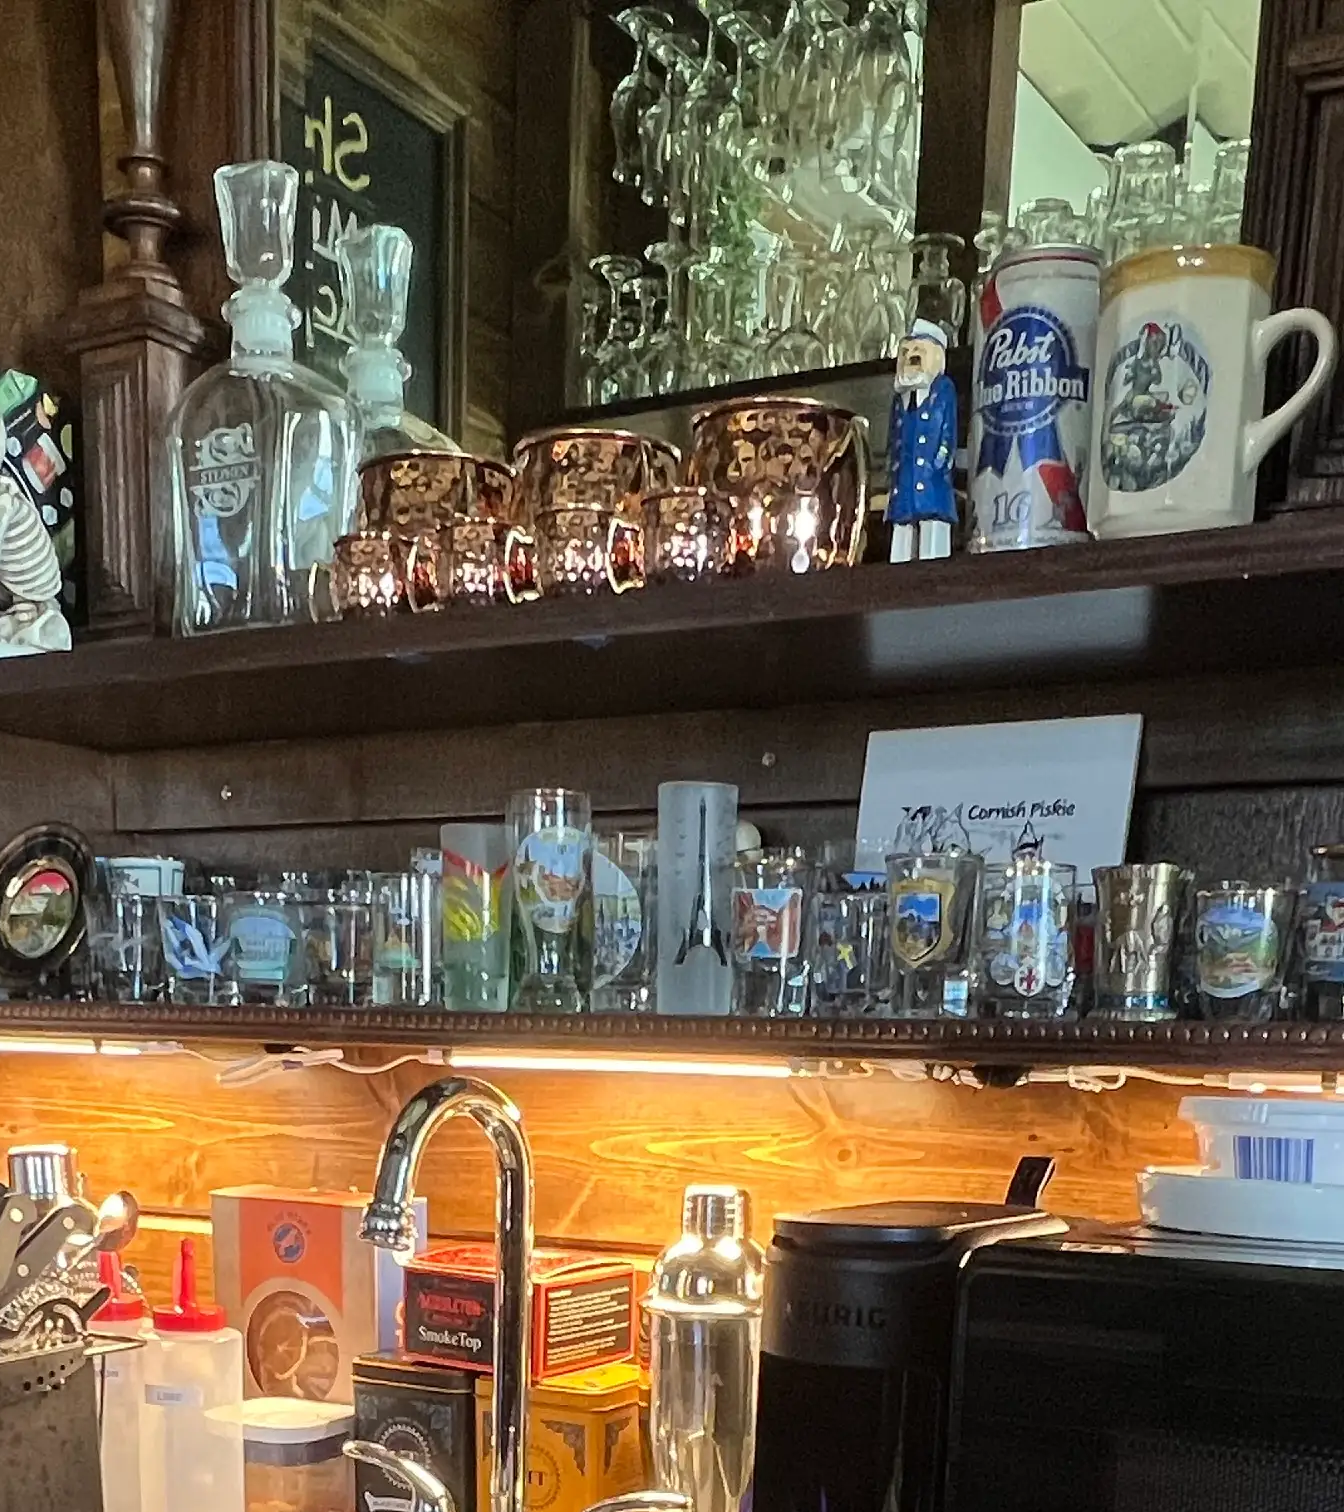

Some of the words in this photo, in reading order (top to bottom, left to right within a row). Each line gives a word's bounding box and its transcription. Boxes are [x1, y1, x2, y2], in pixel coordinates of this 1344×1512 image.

[988, 328, 1056, 372] Pabst
[1005, 368, 1084, 402] Ribbon
[968, 800, 1026, 821] Cornish
[418, 1325, 482, 1353] SmokeTop
